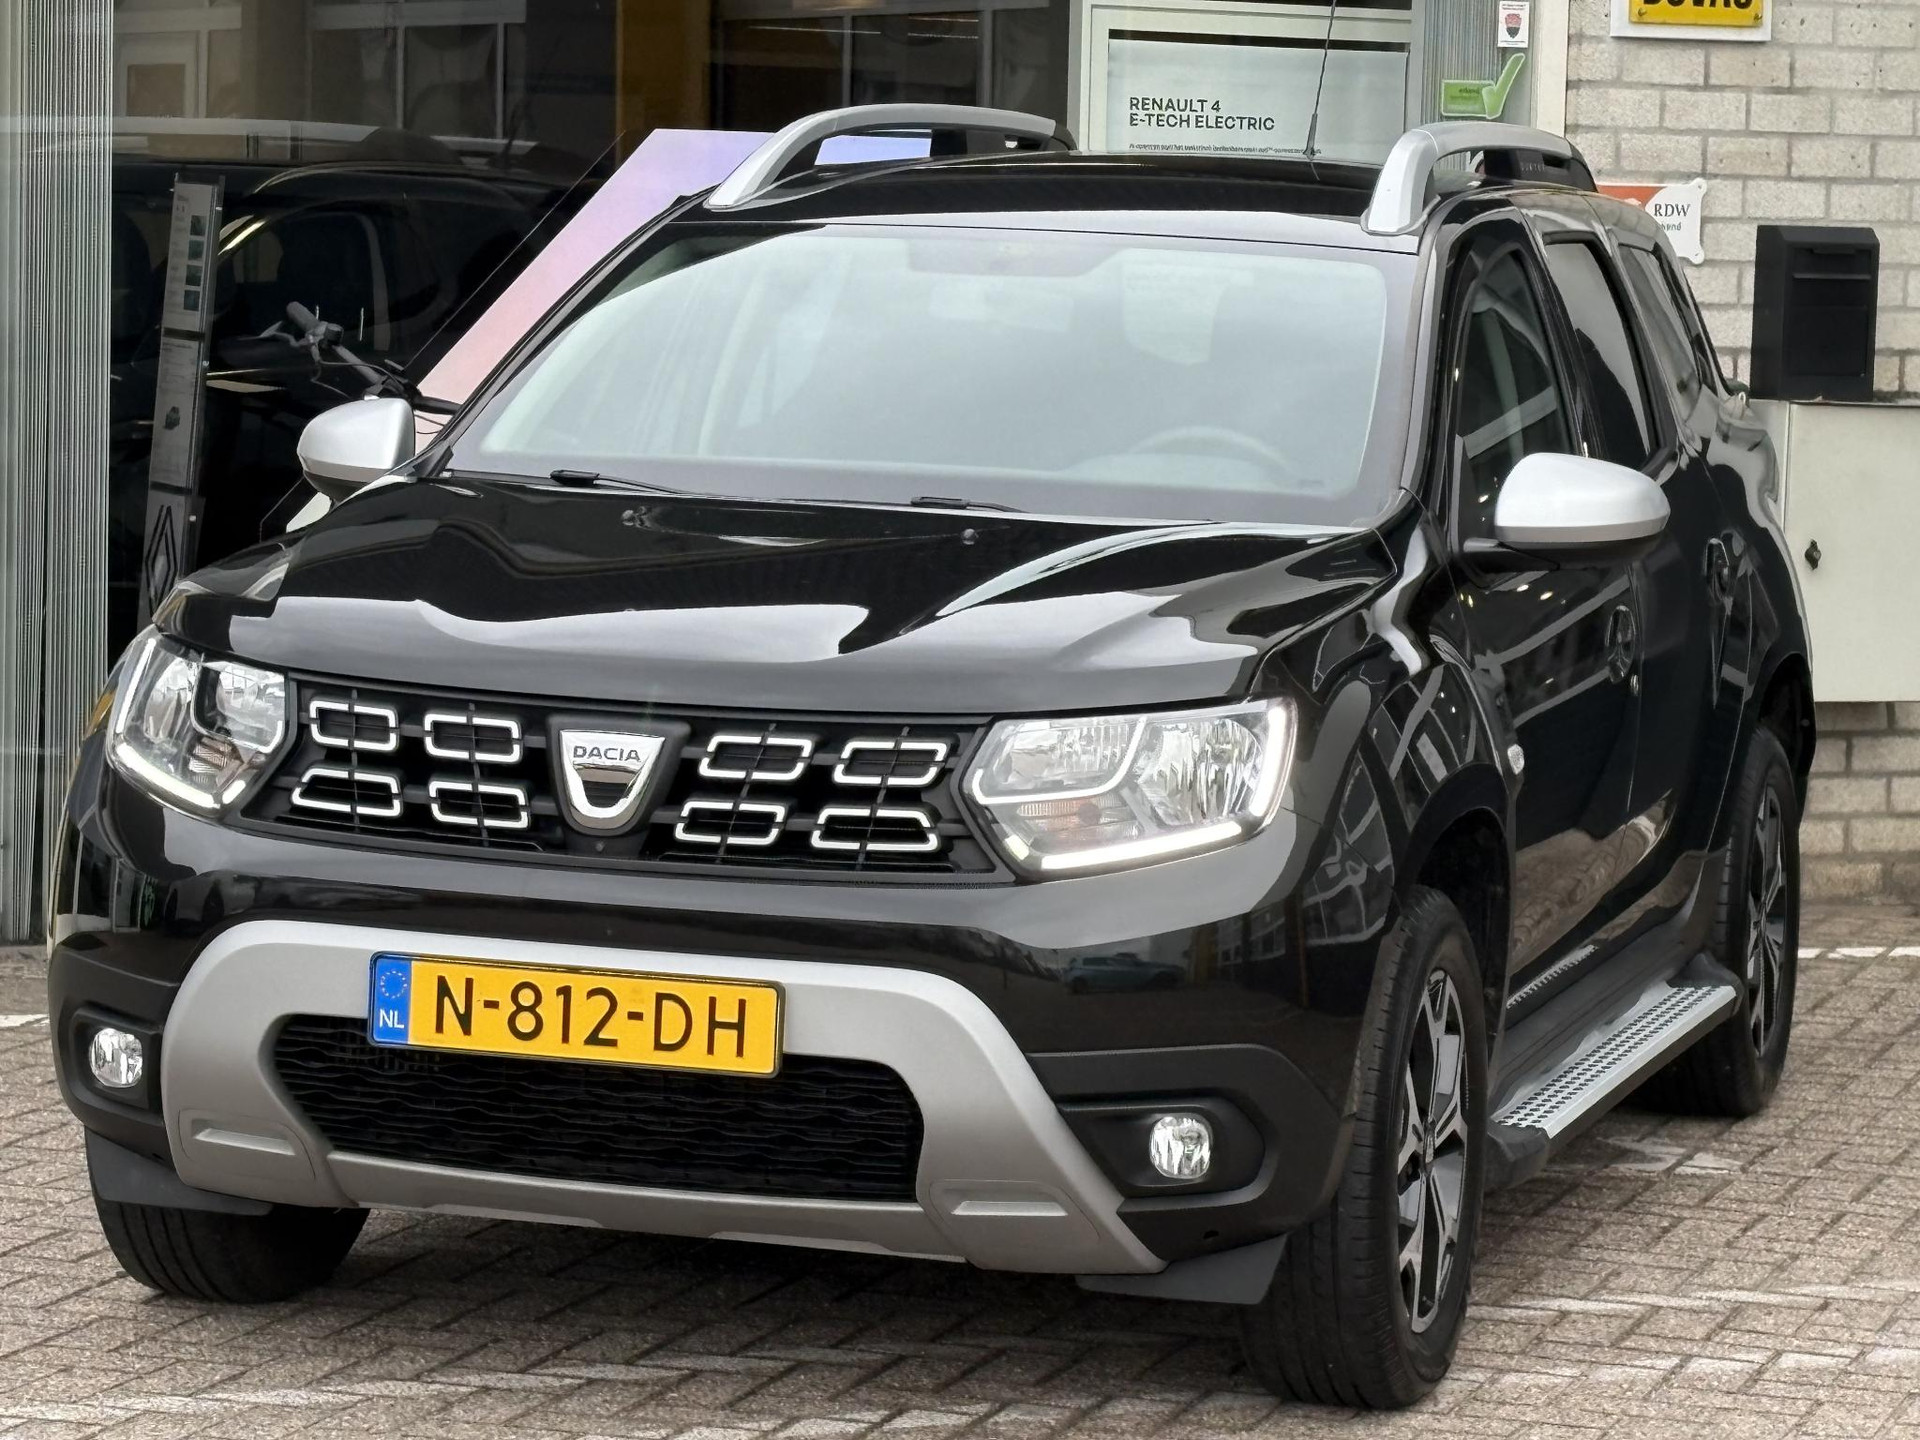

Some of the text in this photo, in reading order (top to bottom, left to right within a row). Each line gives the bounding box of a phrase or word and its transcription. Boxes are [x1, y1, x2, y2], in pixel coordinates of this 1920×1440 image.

[1129, 96, 1221, 113] RENAULT 4
[1129, 112, 1275, 130] E-TECH ELECTRIC
[1654, 203, 1691, 217] RDW
[573, 745, 641, 761] DACIA
[379, 1008, 405, 1029] NL
[434, 974, 747, 1058] N-812-DH
